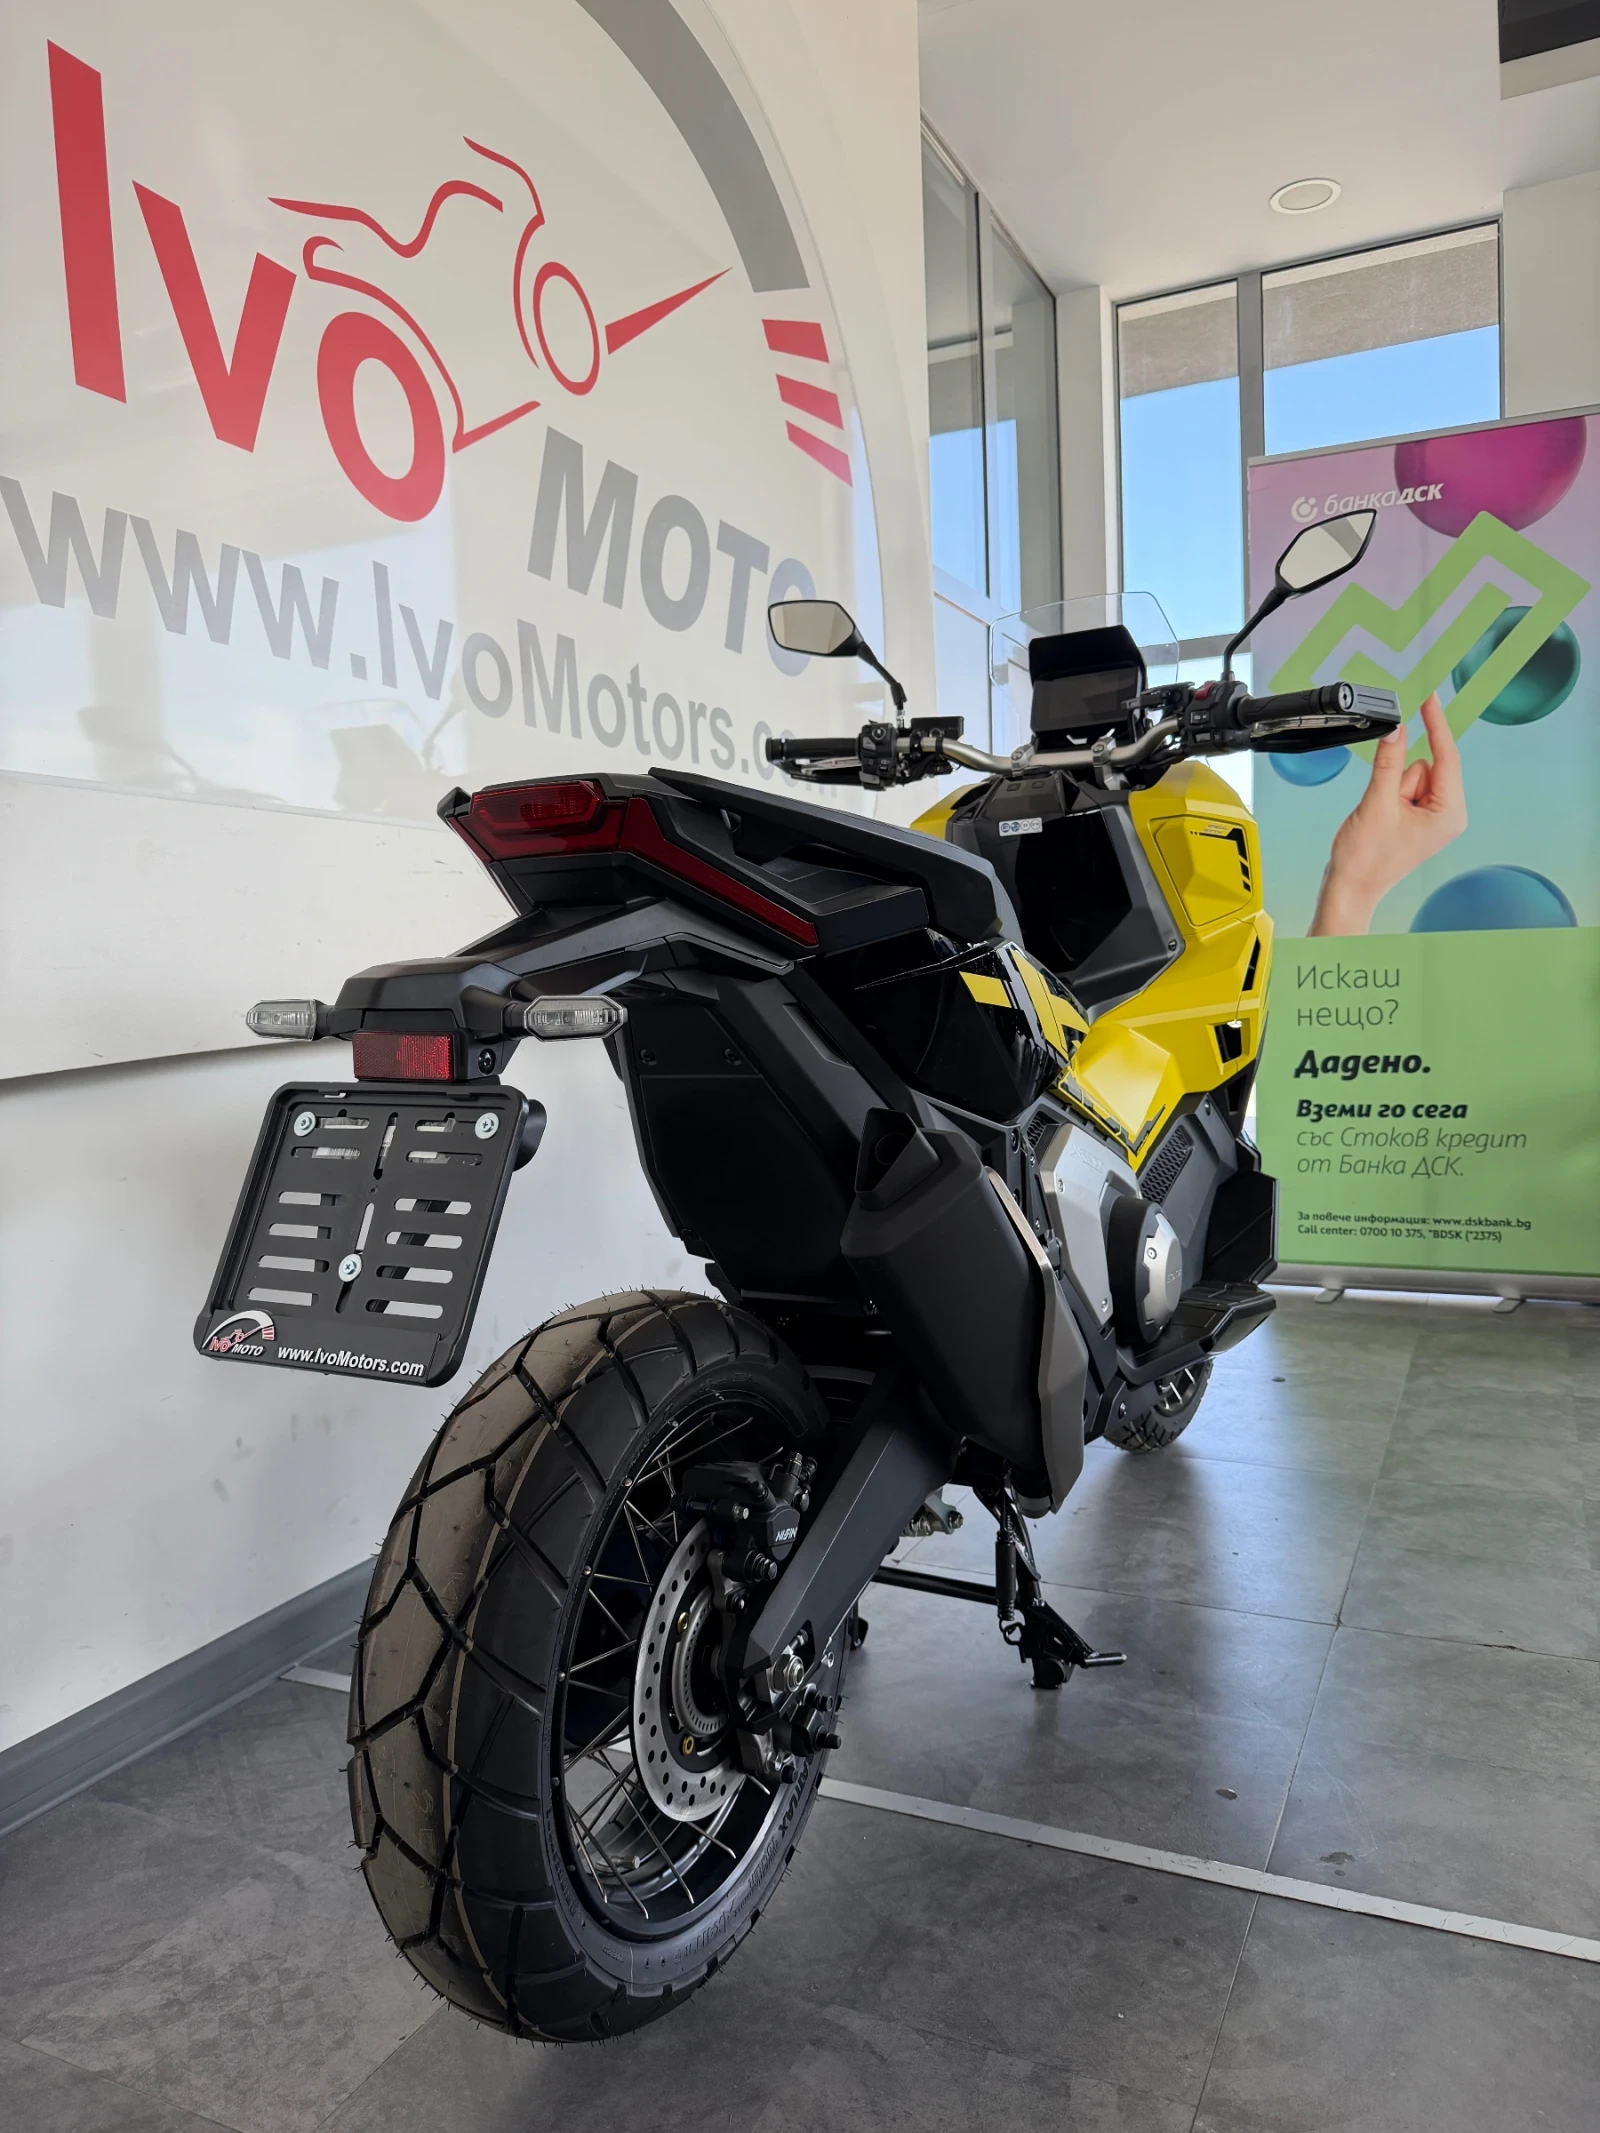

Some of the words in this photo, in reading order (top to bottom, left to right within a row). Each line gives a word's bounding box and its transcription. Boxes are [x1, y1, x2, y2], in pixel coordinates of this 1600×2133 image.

[526, 425, 817, 678] MOTO
[0, 474, 838, 800] www.IvoMotors.c
[1296, 962, 1401, 990] Искаш
[1296, 999, 1401, 1031] нещо?
[1293, 1050, 1432, 1081] Дадено.
[1296, 1099, 1372, 1123] Вземи
[1377, 1103, 1406, 1119] го
[1412, 1103, 1469, 1119] сега
[1296, 1130, 1334, 1147] със
[1340, 1127, 1430, 1148] Стоков
[1436, 1128, 1528, 1154] кредит
[1297, 1157, 1332, 1174] от
[1339, 1154, 1407, 1176] Банка
[1410, 1156, 1465, 1179] ДСК.
[1297, 1224, 1318, 1235] Call
[1320, 1227, 1358, 1236] center:
[1360, 1226, 1388, 1237] 0700
[1390, 1228, 1403, 1238] 10
[1312, 1212, 1352, 1222] повече
[1432, 1216, 1532, 1231] www.dskbank.bg
[231, 1343, 264, 1356] MOTO
[277, 1346, 425, 1377] www.IvoMotors.com
